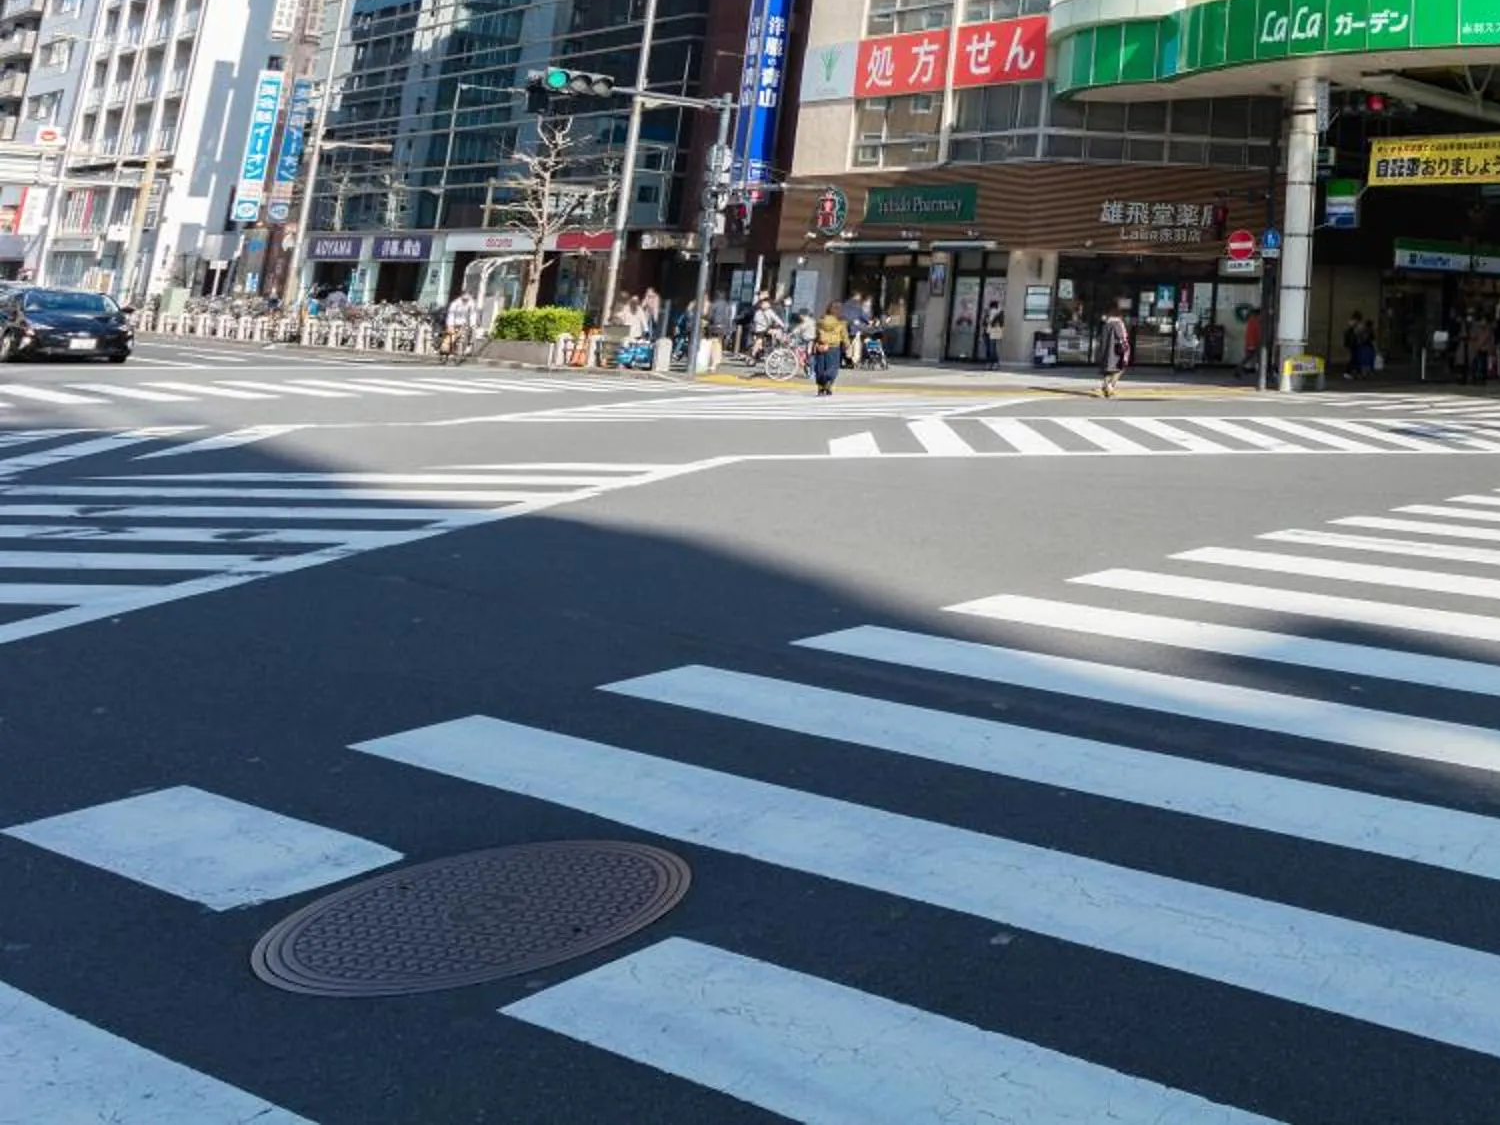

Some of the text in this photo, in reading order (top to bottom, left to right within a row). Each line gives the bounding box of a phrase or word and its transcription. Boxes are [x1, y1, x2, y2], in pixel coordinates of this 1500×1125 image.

[1334, 8, 1409, 36] ガーデン
[758, 16, 786, 107] 洋服の青山
[864, 27, 1036, 89] 処方せん
[315, 240, 353, 256] AOYAMA
